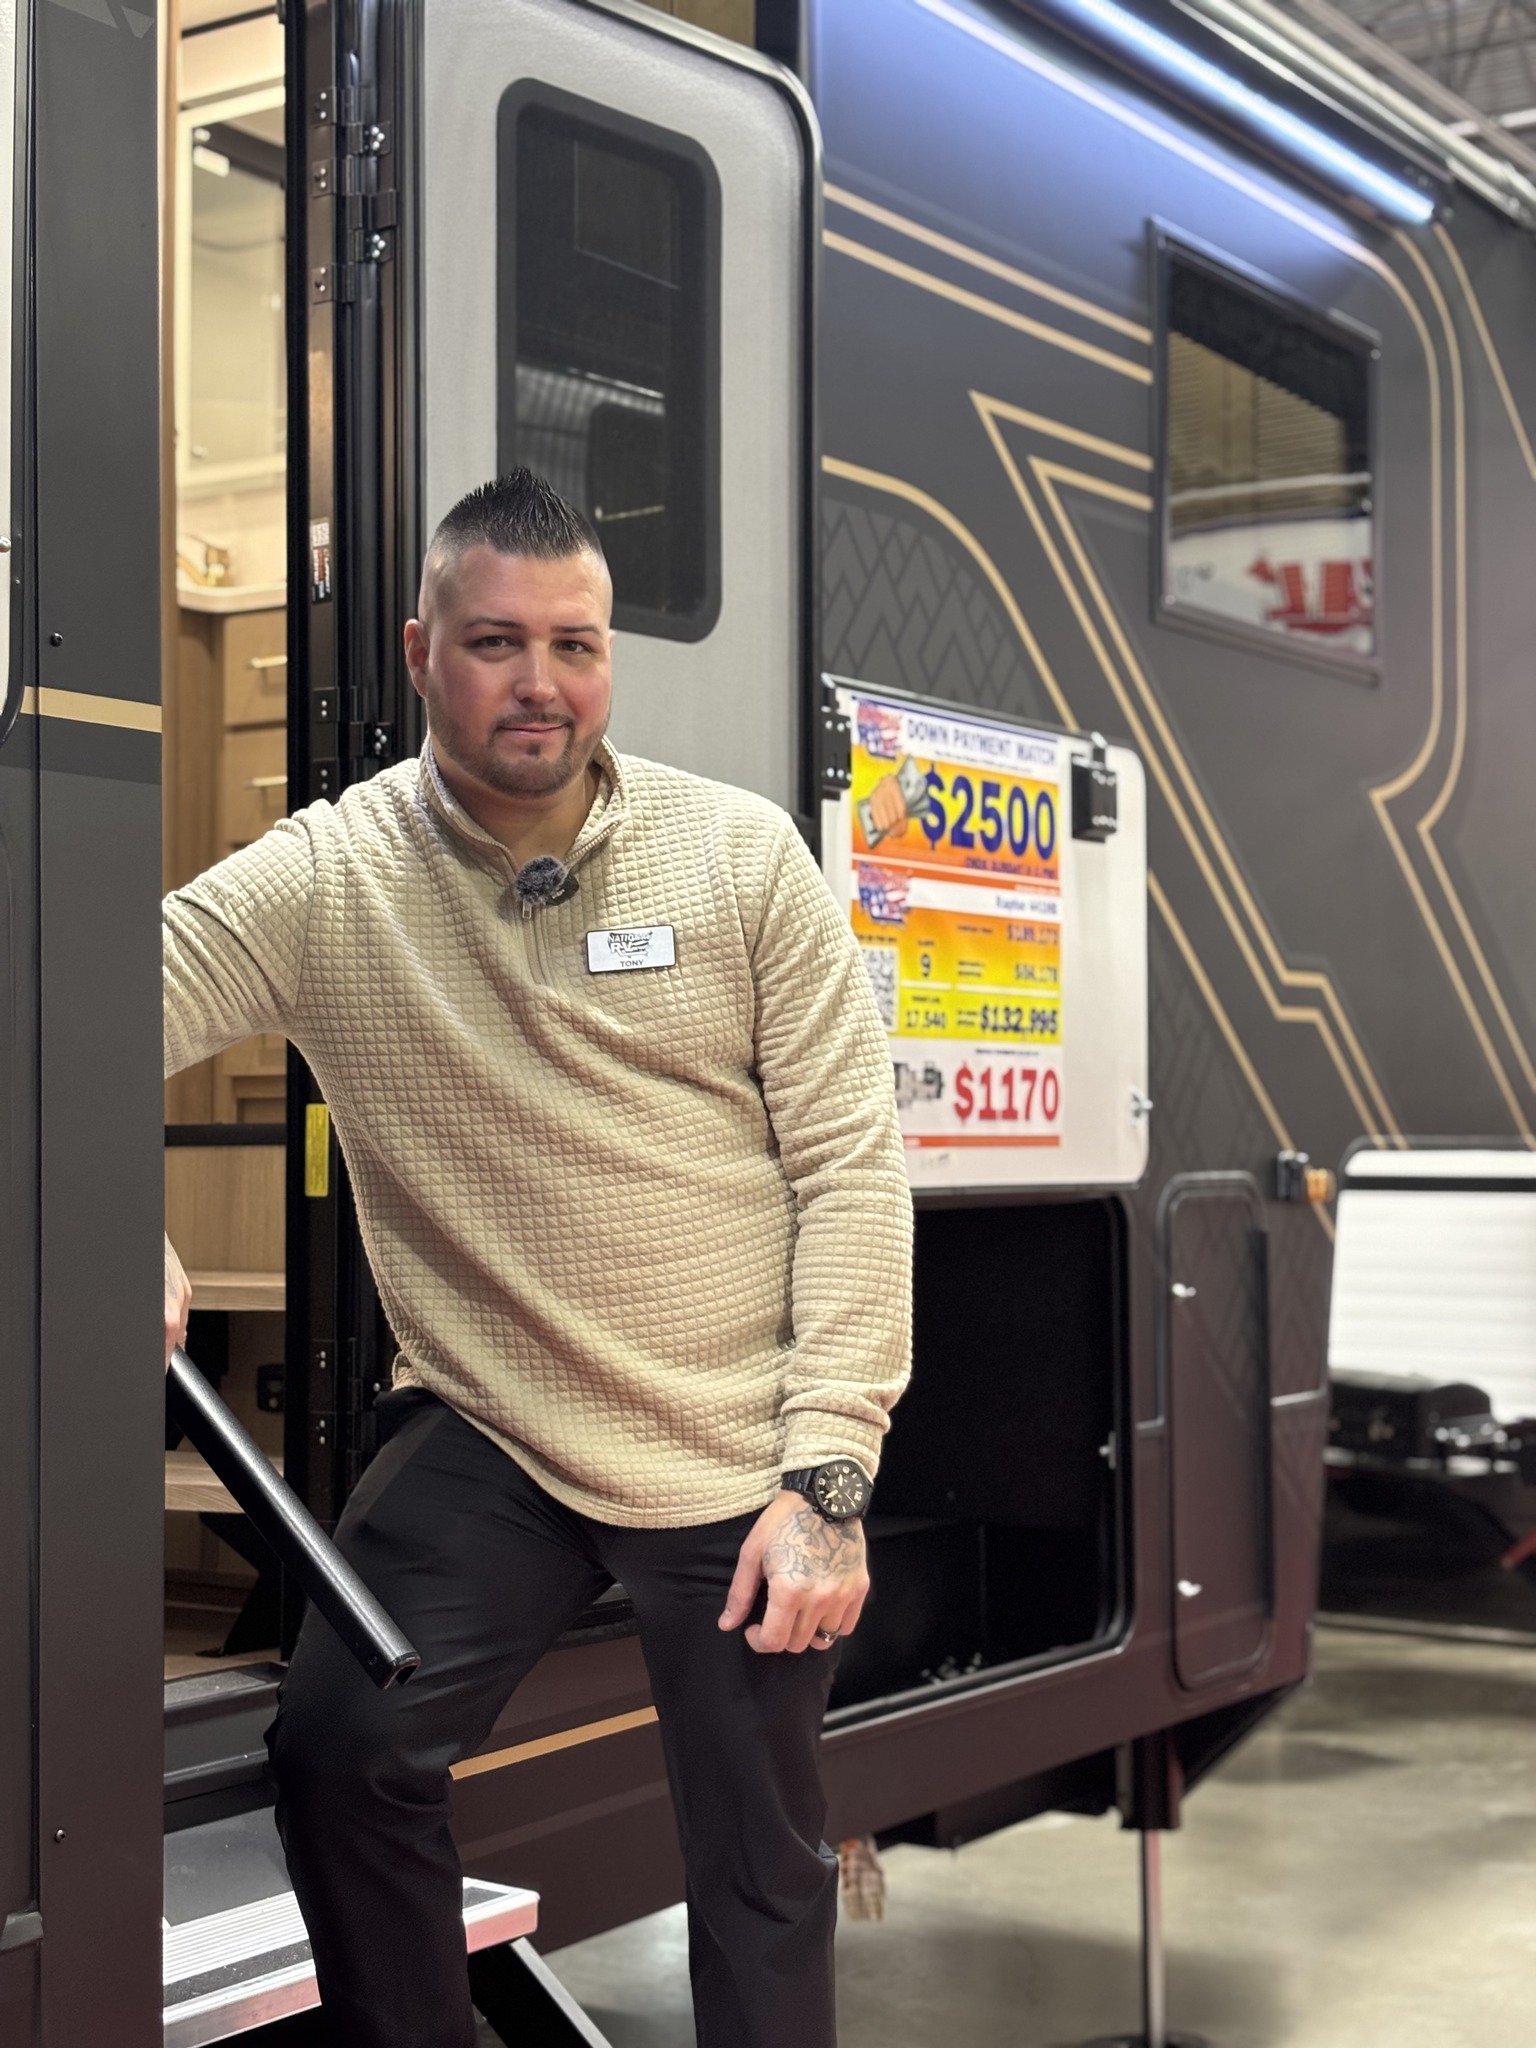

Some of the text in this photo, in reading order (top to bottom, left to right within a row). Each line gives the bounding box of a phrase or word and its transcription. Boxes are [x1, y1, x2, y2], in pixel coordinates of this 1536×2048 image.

[908, 719, 948, 743] DOWN
[954, 729, 1011, 757] PAYMENT
[921, 762, 1055, 861] $2500
[610, 941, 633, 955] RV
[921, 953, 931, 978] 9
[981, 1004, 1057, 1036] $132,995
[954, 1060, 1059, 1127] $1170
